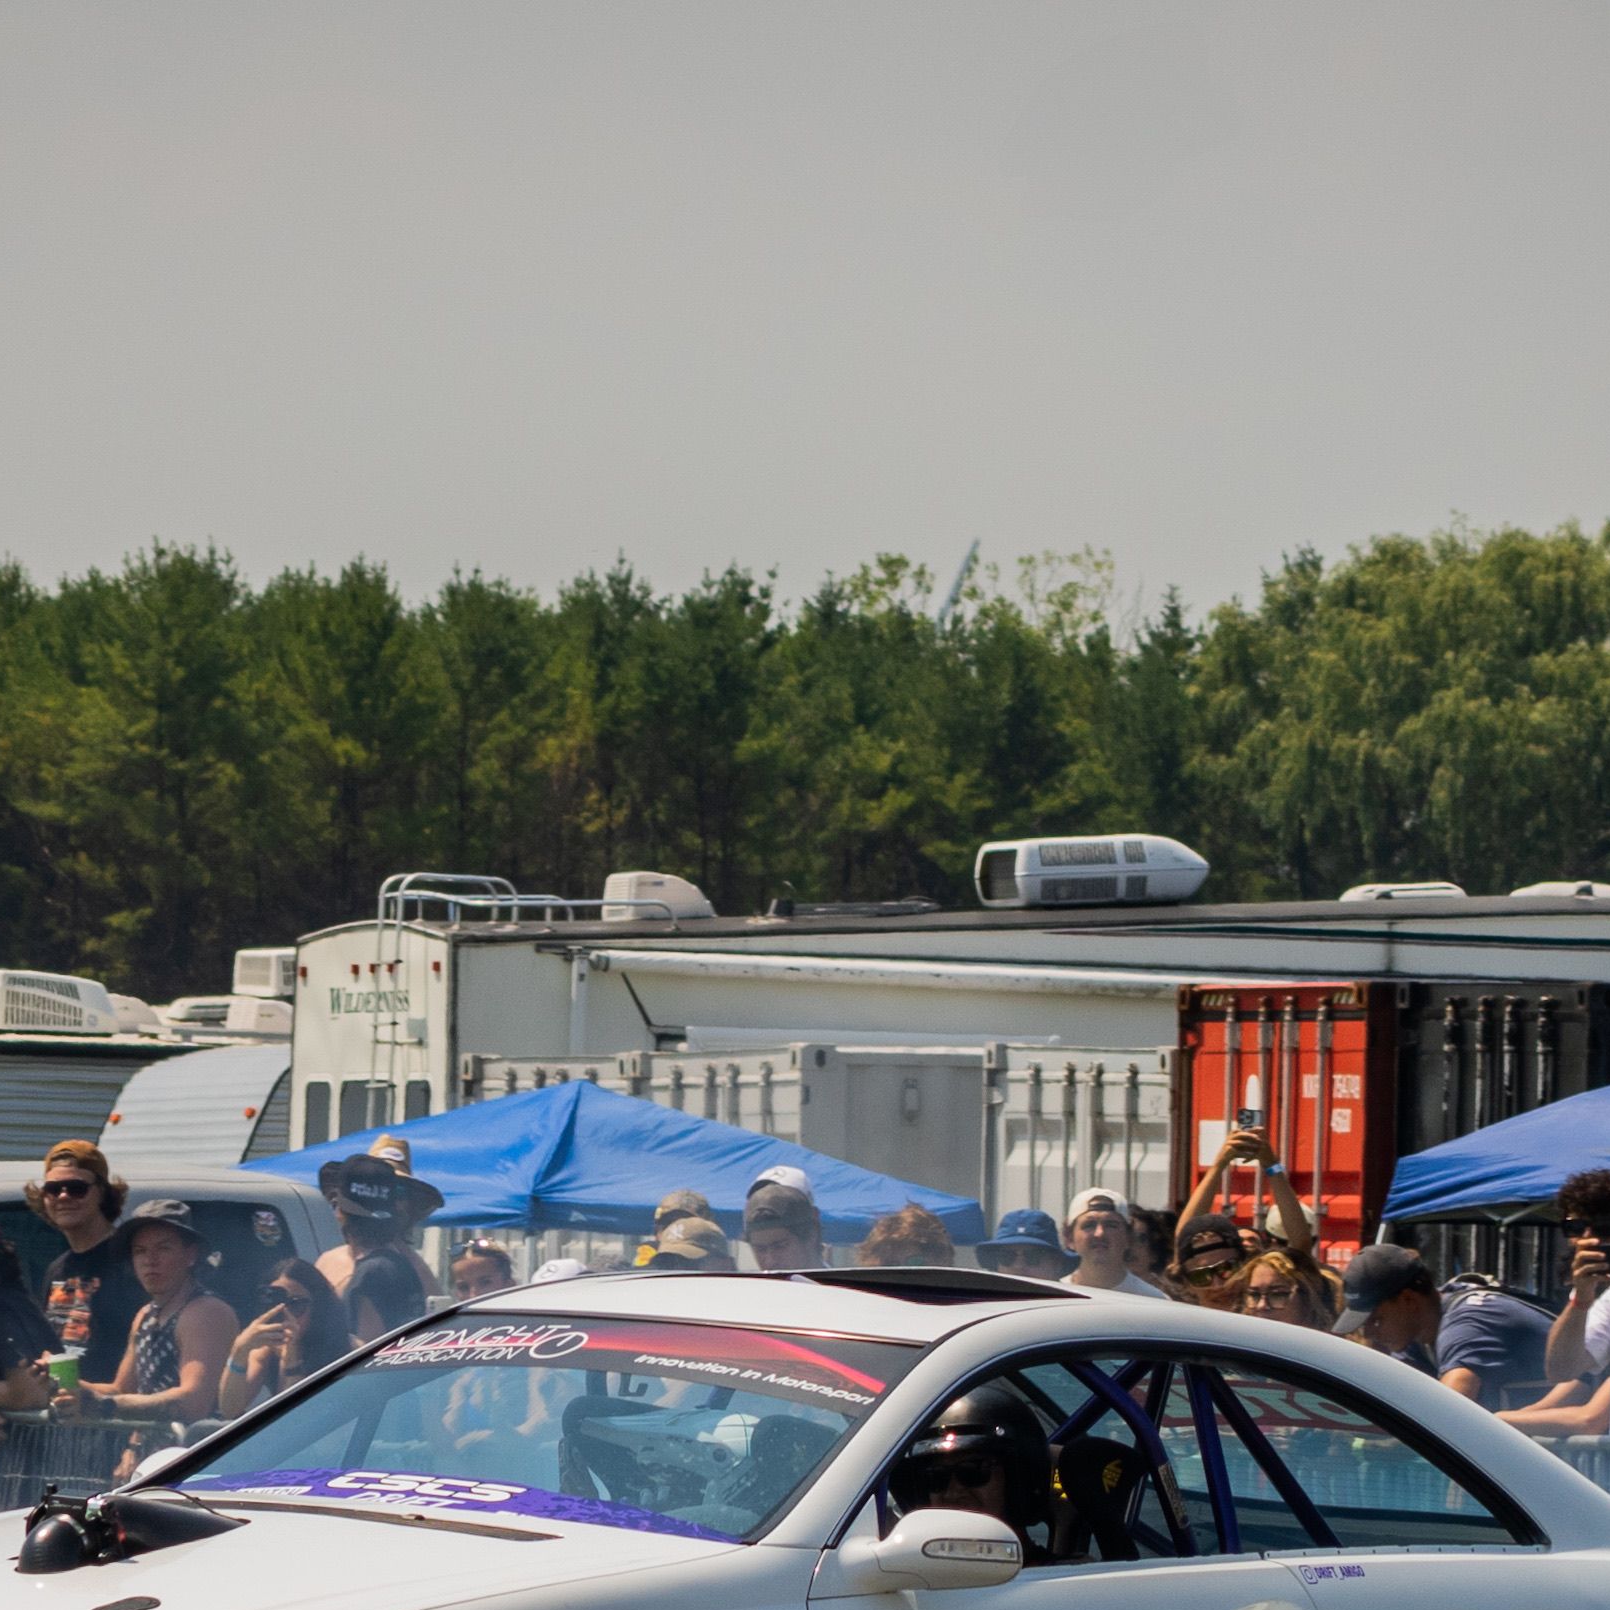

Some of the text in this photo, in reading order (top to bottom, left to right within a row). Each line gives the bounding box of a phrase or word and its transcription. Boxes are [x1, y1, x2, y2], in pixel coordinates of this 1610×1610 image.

[374, 1324, 571, 1357] MIDNIGHT
[364, 1346, 523, 1367] FABRICATION
[634, 1354, 739, 1376] Innovation
[763, 1373, 876, 1405] Motorsport
[327, 1472, 527, 1502] CSCS
